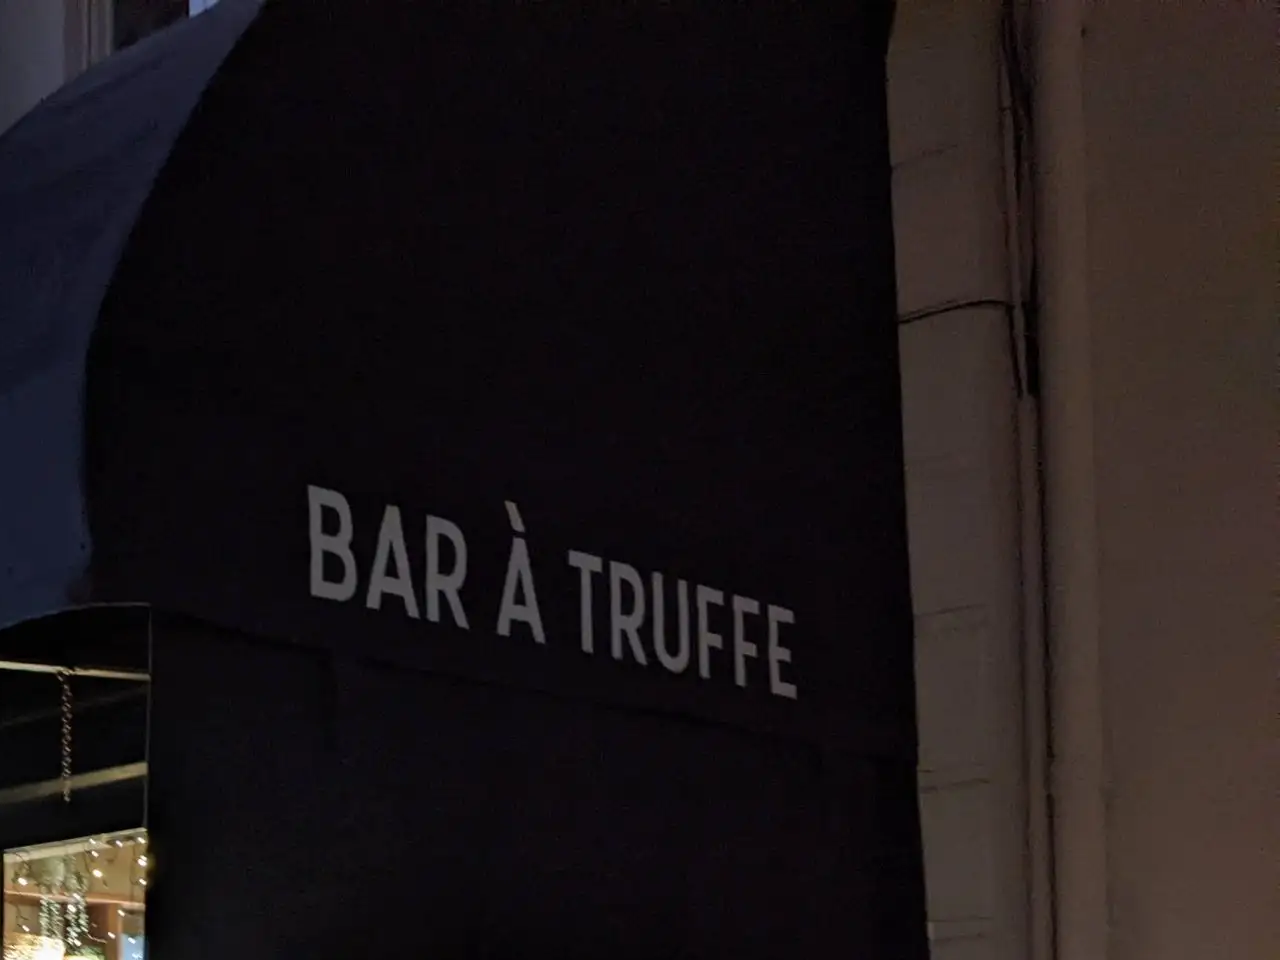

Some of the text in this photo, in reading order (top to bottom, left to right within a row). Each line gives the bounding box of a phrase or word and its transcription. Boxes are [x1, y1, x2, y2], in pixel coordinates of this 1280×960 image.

[307, 484, 798, 700] BAR À TRUFFE
